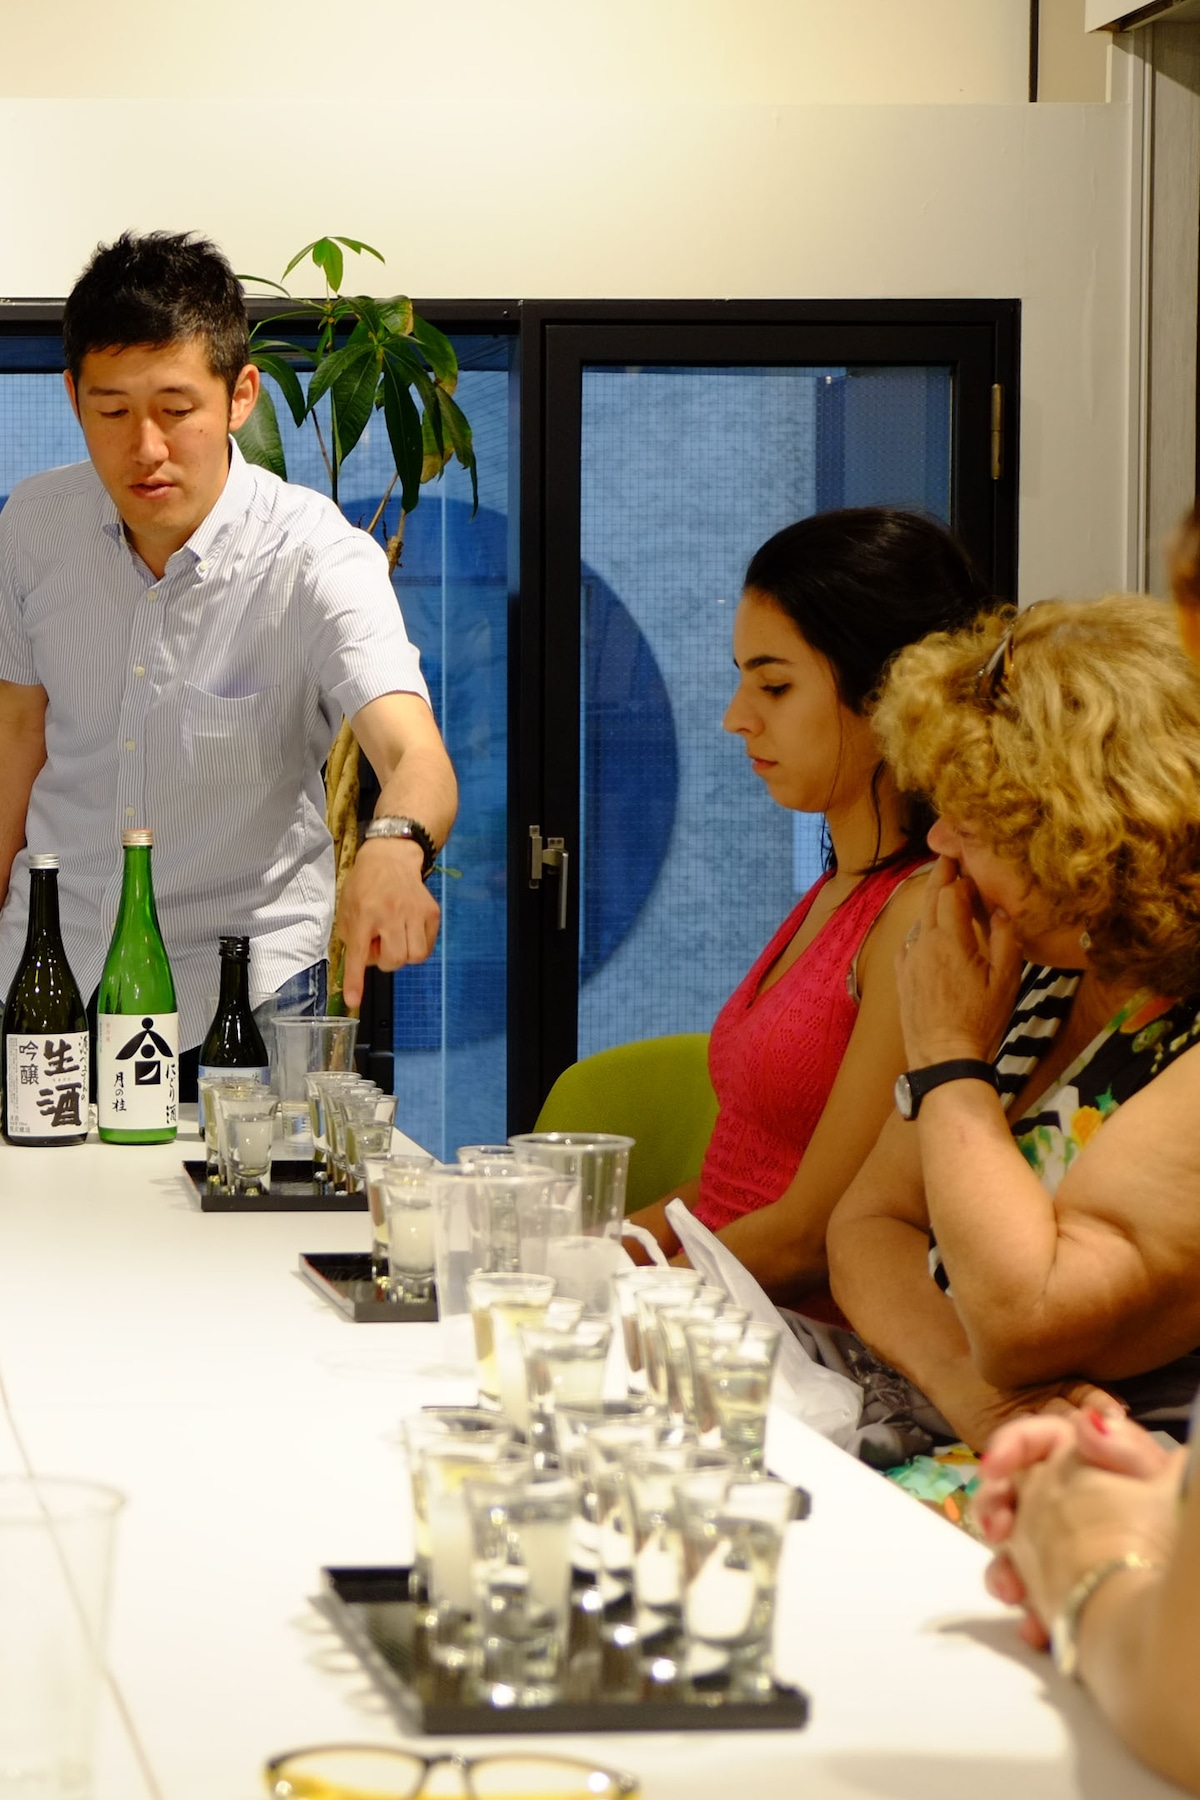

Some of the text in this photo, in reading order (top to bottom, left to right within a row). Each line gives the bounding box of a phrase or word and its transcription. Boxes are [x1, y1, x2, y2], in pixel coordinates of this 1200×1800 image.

[19, 1040, 40, 1085] 吟醸
[36, 1039, 82, 1127] 生酒
[112, 1071, 127, 1112] 月の桂
